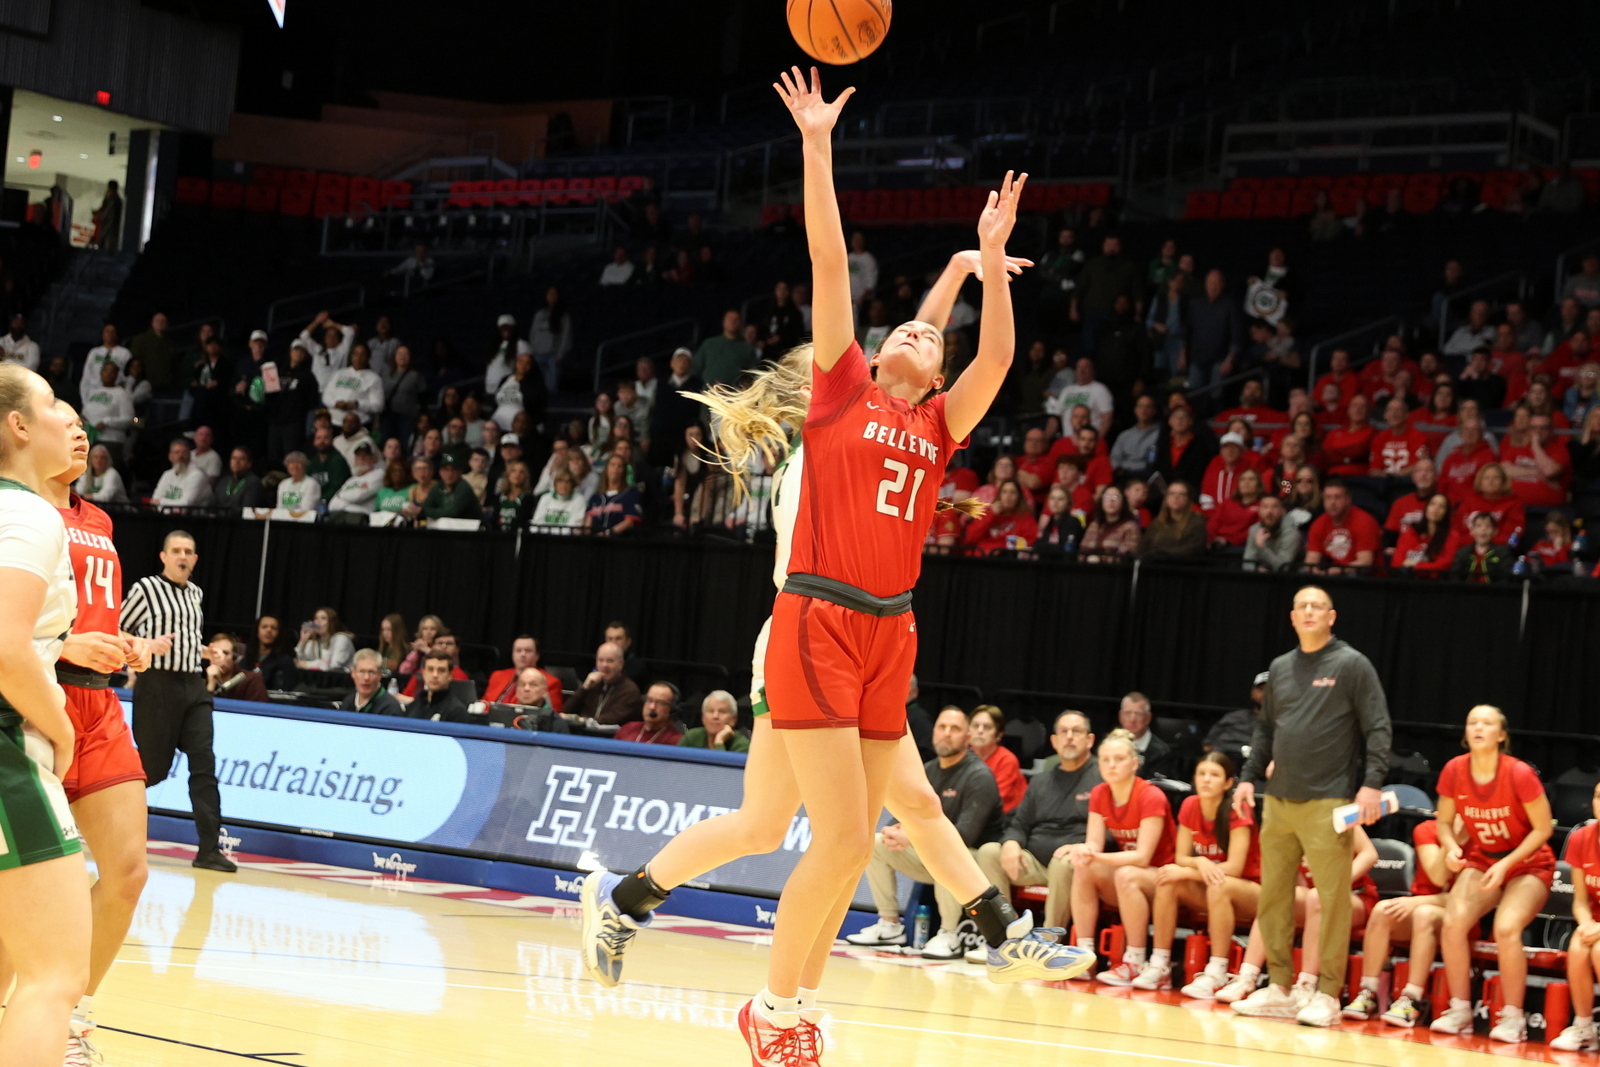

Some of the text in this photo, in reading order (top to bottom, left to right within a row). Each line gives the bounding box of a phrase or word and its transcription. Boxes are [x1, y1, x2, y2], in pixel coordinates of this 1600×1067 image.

[862, 421, 939, 465] BELLEVUE
[876, 457, 926, 522] 21
[85, 555, 114, 609] 14
[215, 750, 404, 816] ndraising.
[526, 764, 617, 849] H
[1464, 805, 1511, 820] BELLEVUE
[219, 827, 242, 851] roger
[1474, 820, 1511, 844] 24
[385, 852, 418, 879] Kroger
